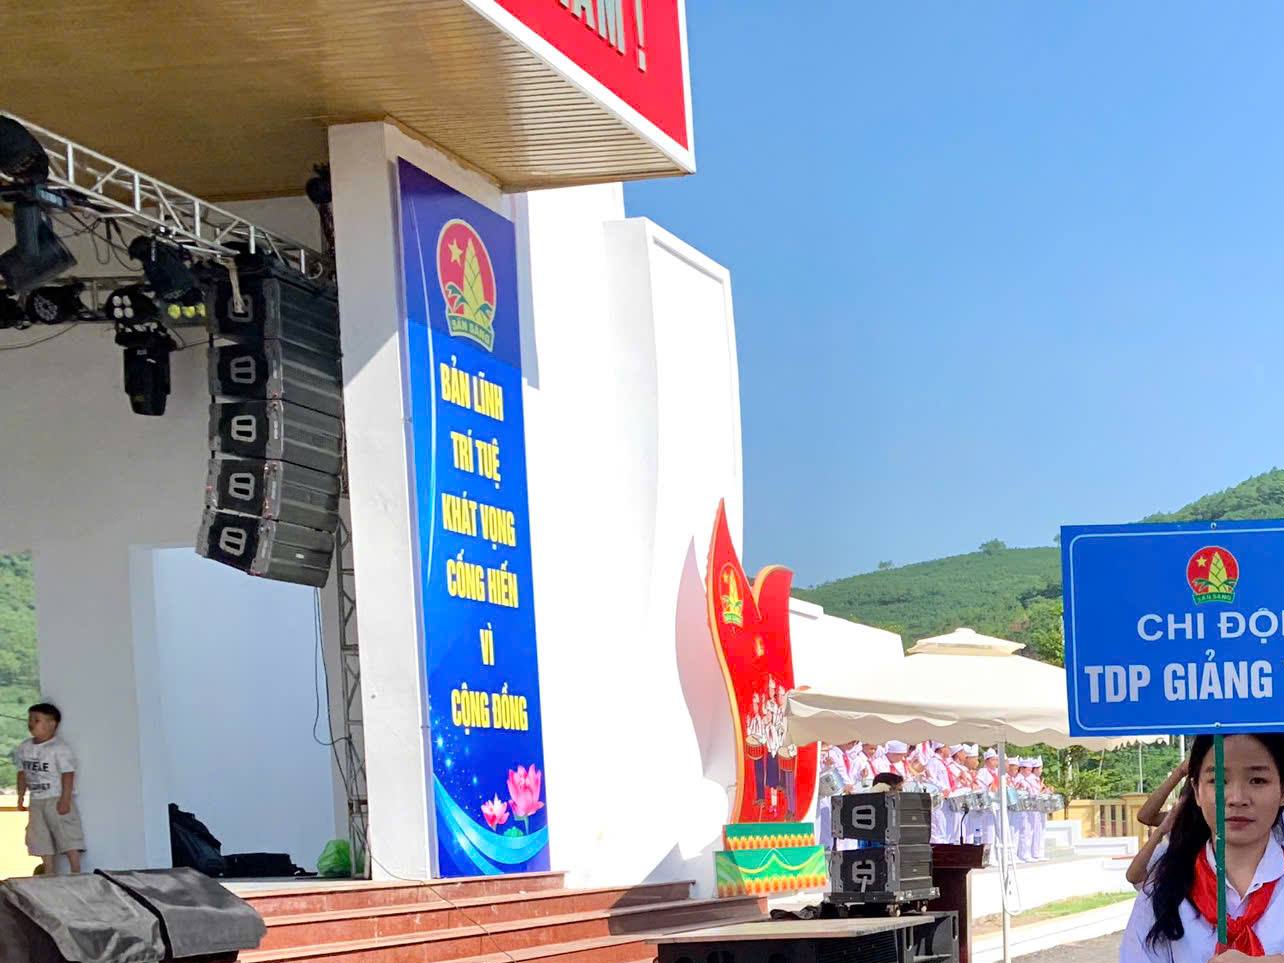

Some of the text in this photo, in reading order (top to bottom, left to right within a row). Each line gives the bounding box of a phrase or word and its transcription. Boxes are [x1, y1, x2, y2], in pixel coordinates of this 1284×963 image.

[440, 355, 504, 421] BẢN LĨNH
[451, 429, 501, 489] TRÍ TUỆ
[442, 491, 517, 550] KHÁT VỌNG
[447, 549, 519, 609] CỐNG HIẾN
[480, 622, 495, 666] VÌ
[1137, 612, 1205, 641] CHI
[1084, 664, 1151, 703] TDP
[1163, 649, 1273, 701] GIẢNG
[451, 682, 529, 736] CỘNG ĐỒNG
